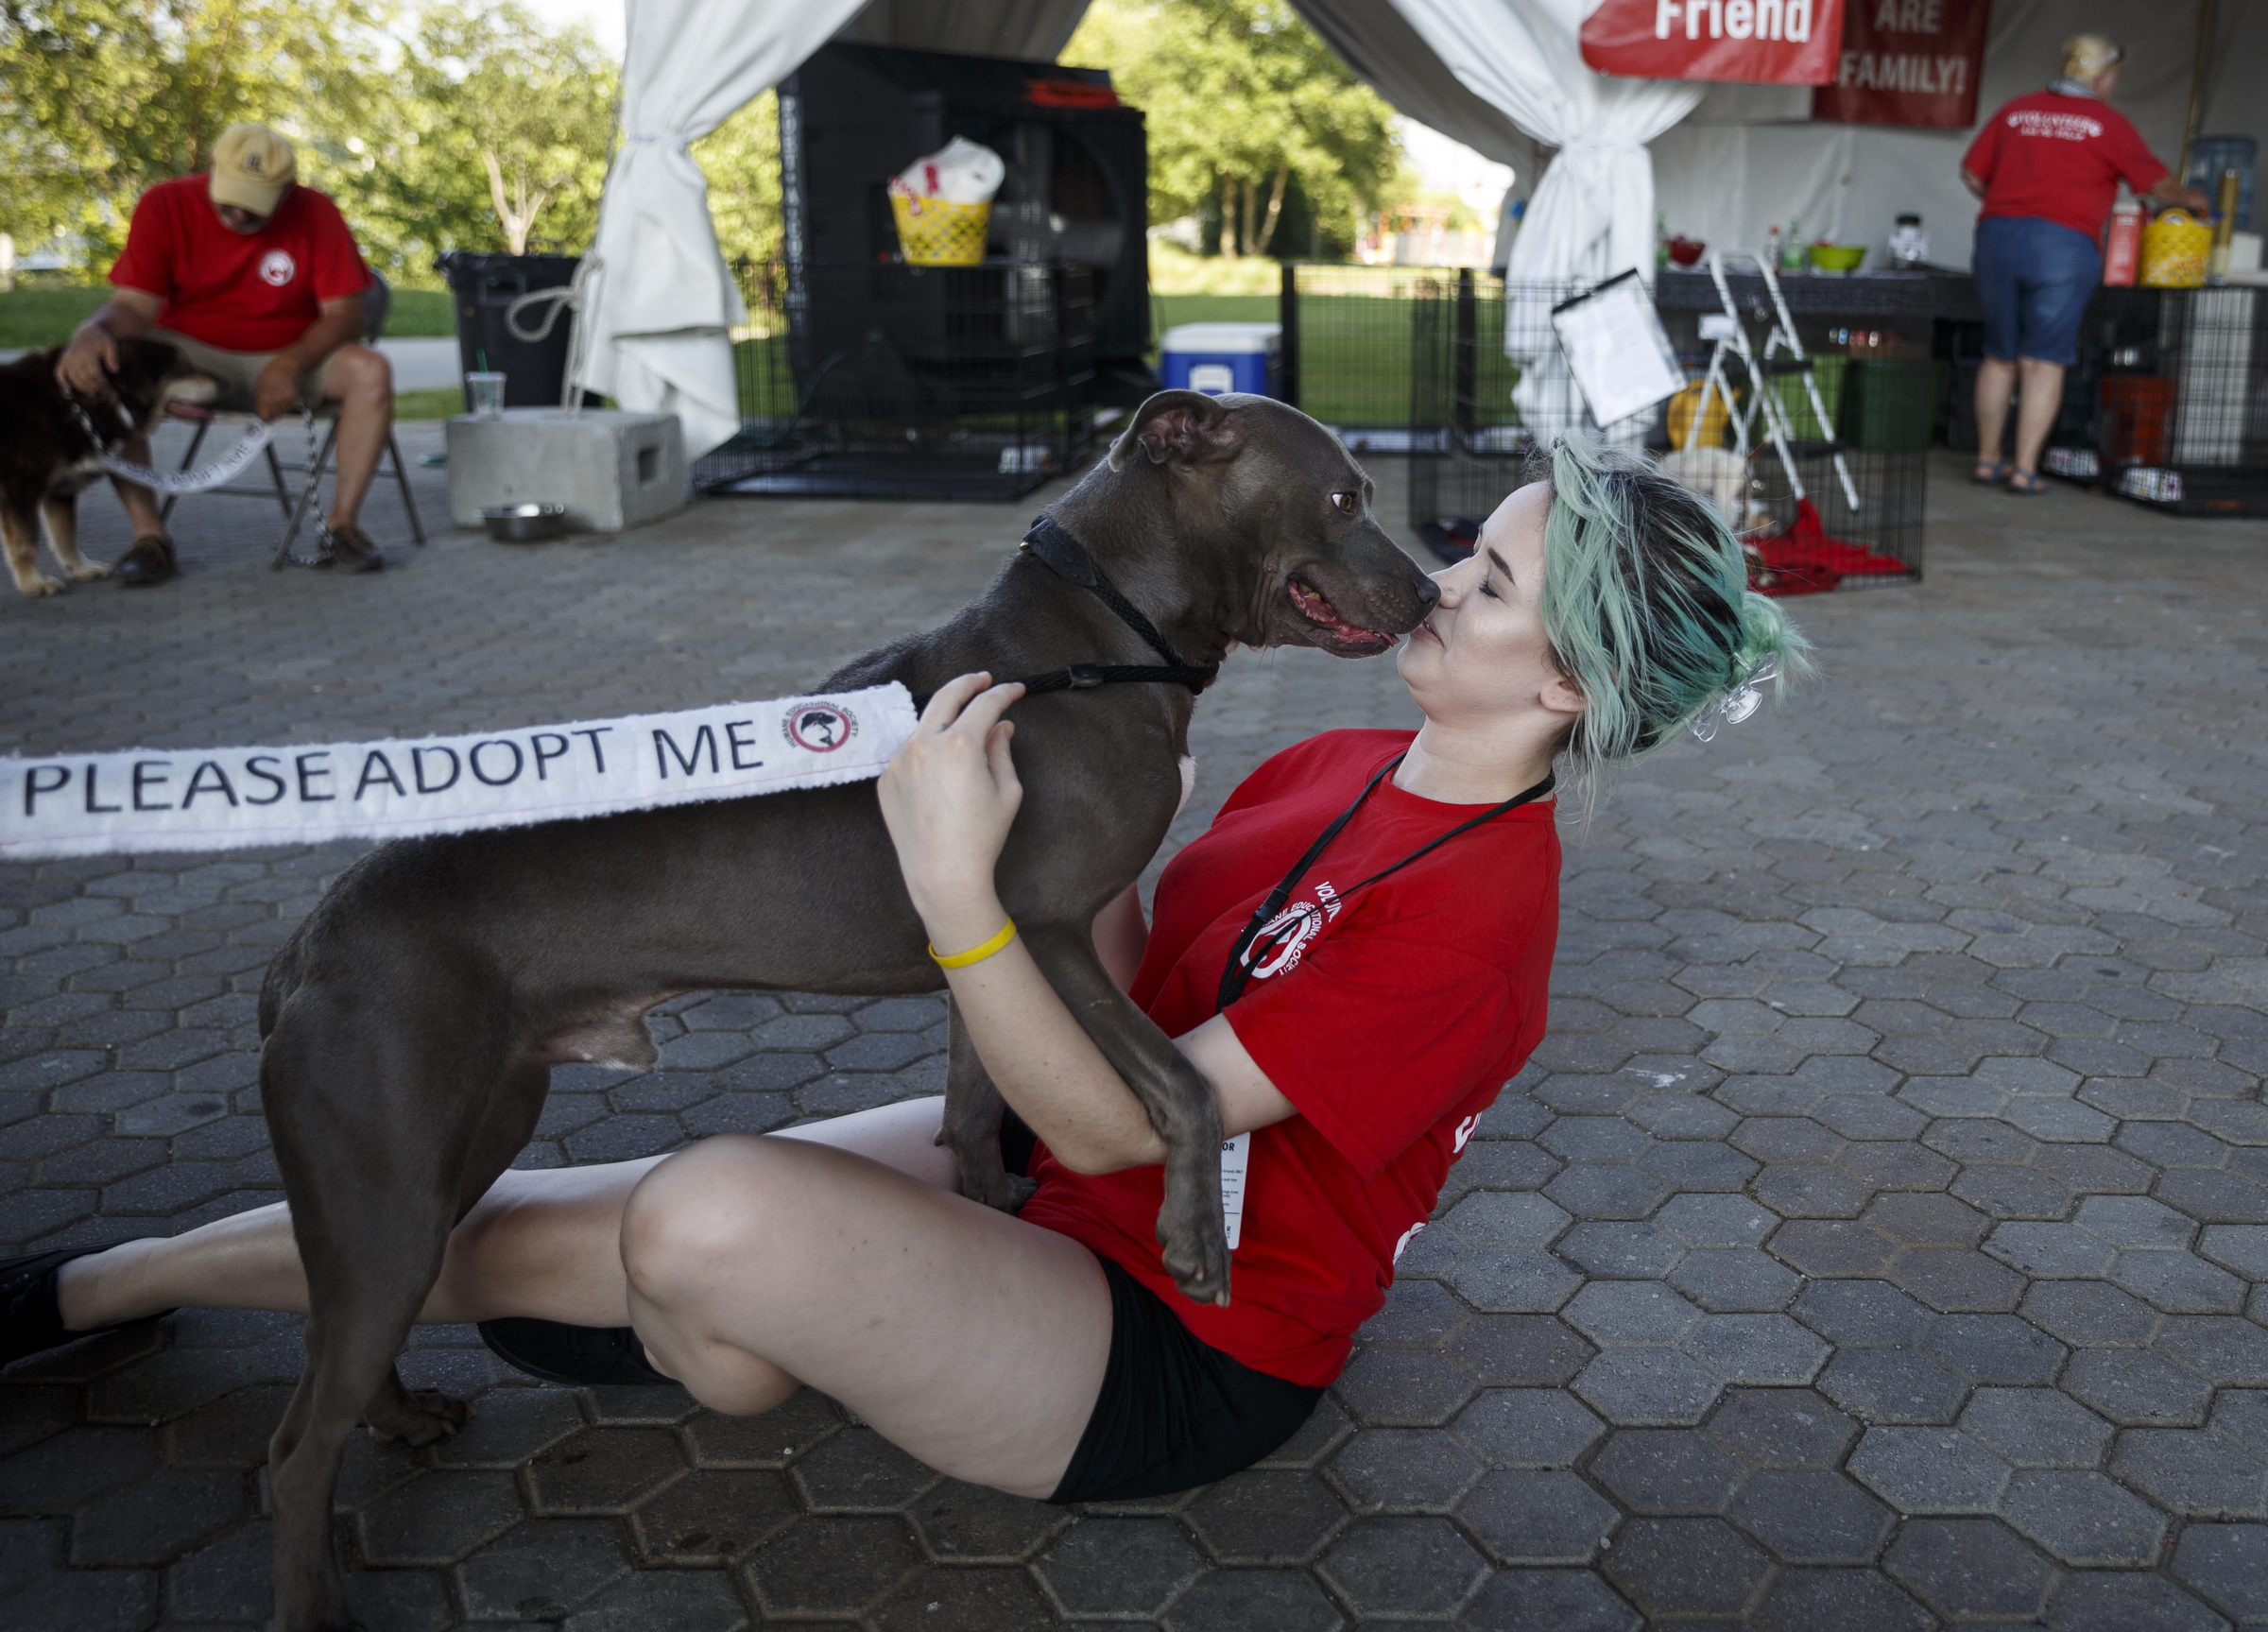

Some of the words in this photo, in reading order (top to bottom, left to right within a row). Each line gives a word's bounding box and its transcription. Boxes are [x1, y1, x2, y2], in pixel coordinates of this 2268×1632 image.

[1655, 0, 1811, 43] Friend
[1874, 0, 1941, 34] ARE
[1839, 50, 1968, 95] FAMILY!
[785, 701, 840, 717] EDUCATIONAL
[841, 707, 859, 738] SOCIETY
[782, 718, 799, 748] HUMANE
[25, 752, 336, 817] PLEASE
[353, 727, 613, 801] ADOPT
[652, 720, 764, 780] ME
